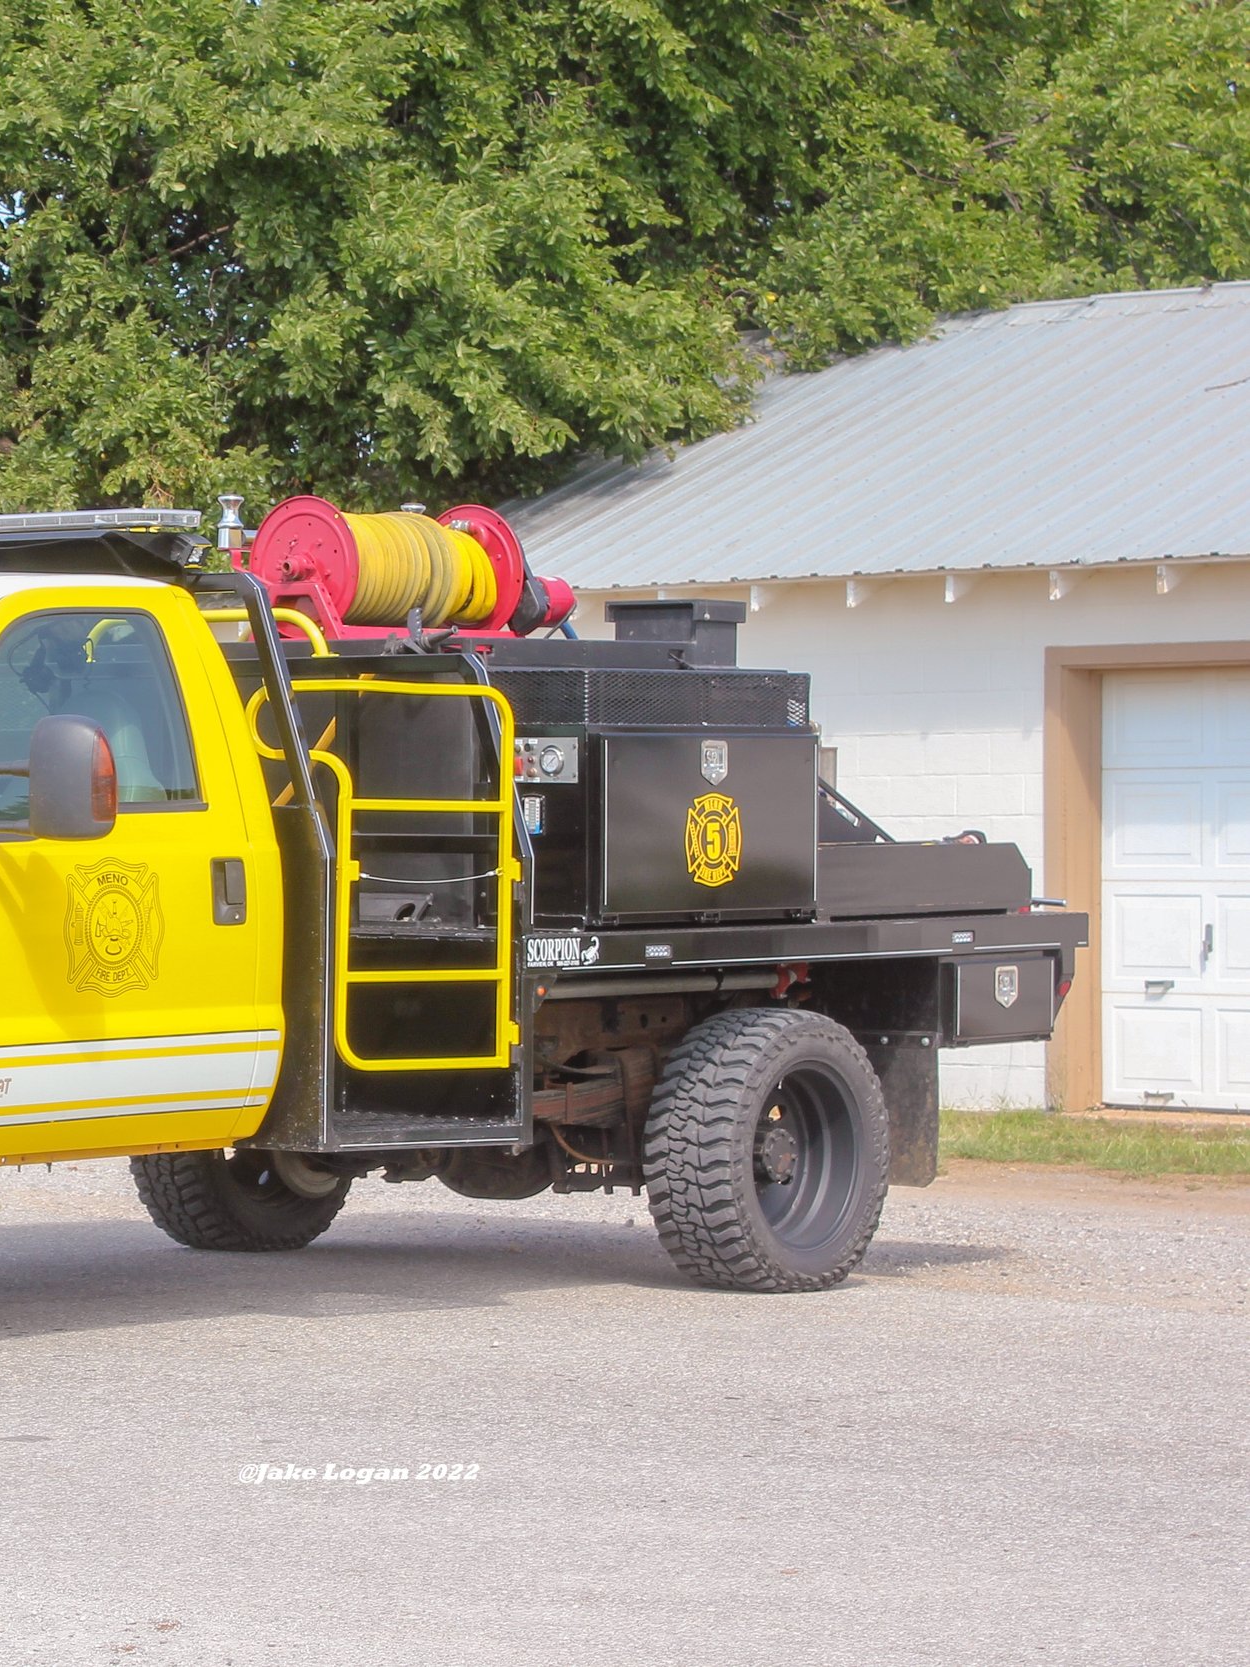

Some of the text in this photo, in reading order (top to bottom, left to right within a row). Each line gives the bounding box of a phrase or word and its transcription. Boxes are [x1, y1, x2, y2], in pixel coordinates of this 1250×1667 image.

[706, 822, 721, 860] 5
[97, 873, 129, 887] MENO
[527, 937, 581, 961] SCORPION
[96, 967, 110, 982] FIRE
